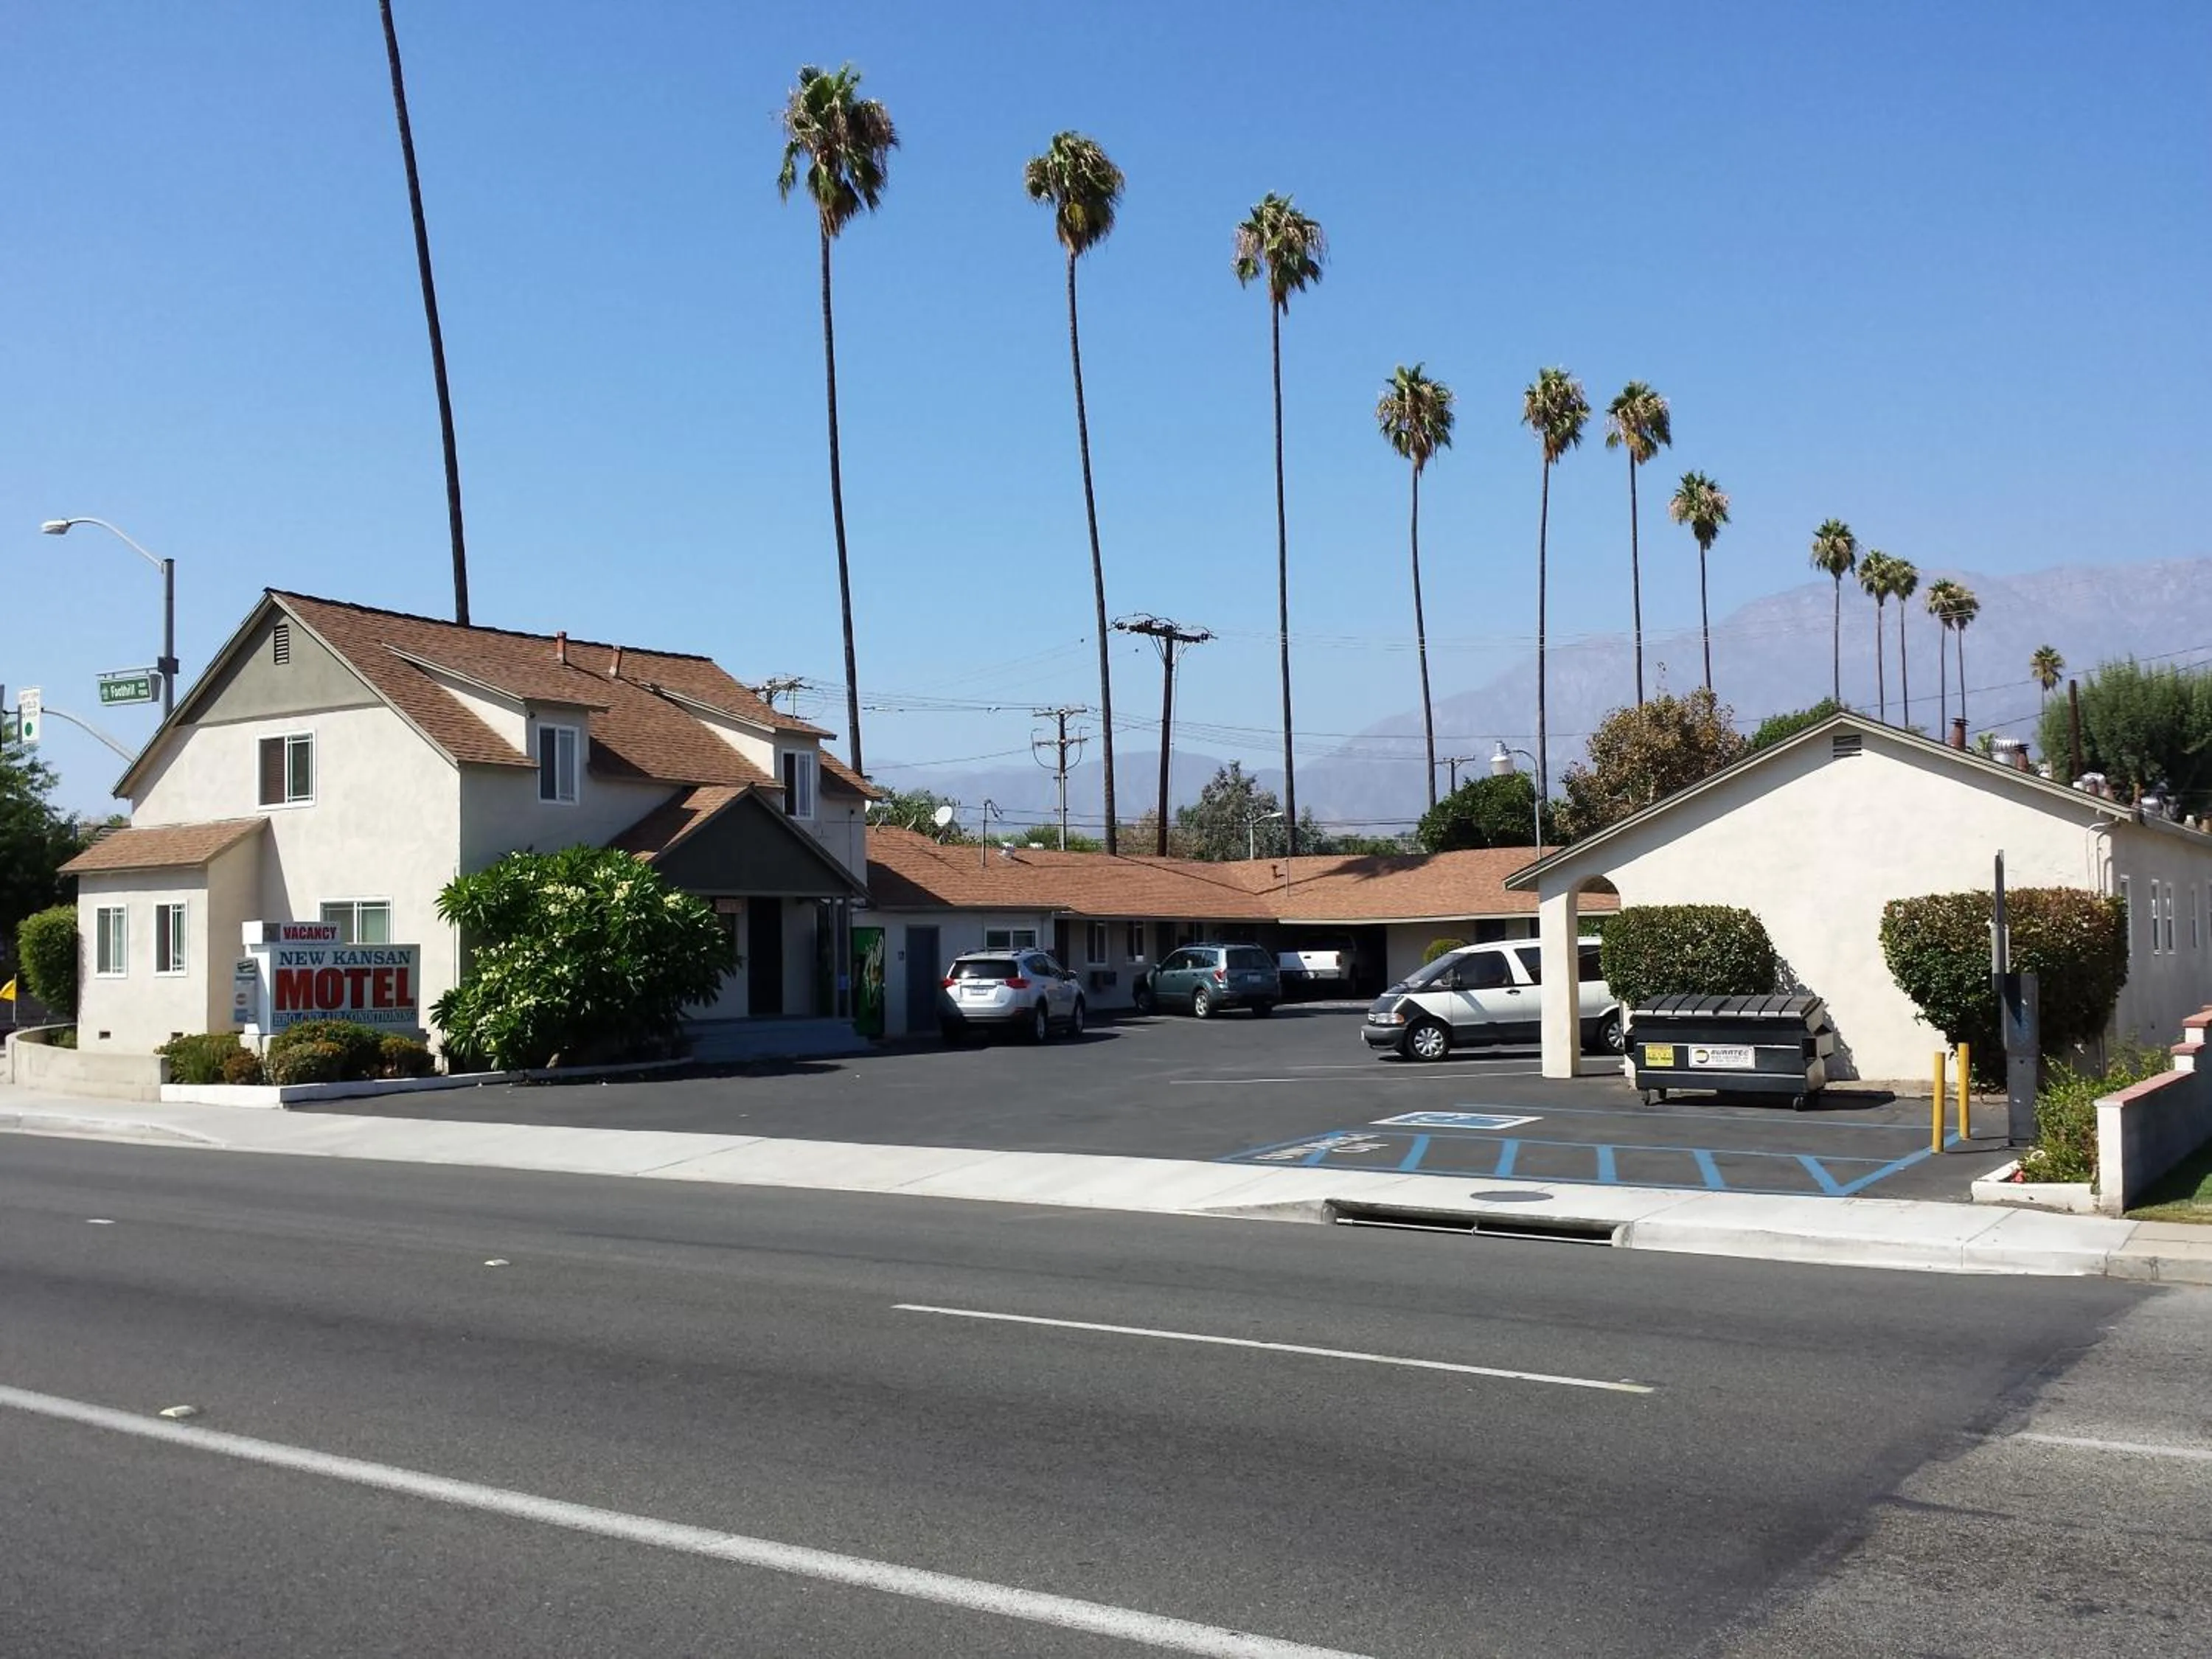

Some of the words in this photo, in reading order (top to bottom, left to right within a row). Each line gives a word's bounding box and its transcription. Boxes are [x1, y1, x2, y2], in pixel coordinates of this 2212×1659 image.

[283, 926, 337, 940] VACANCY
[279, 951, 325, 965] NEW
[333, 950, 411, 965] KANSAN
[275, 967, 414, 1011] MOTEL
